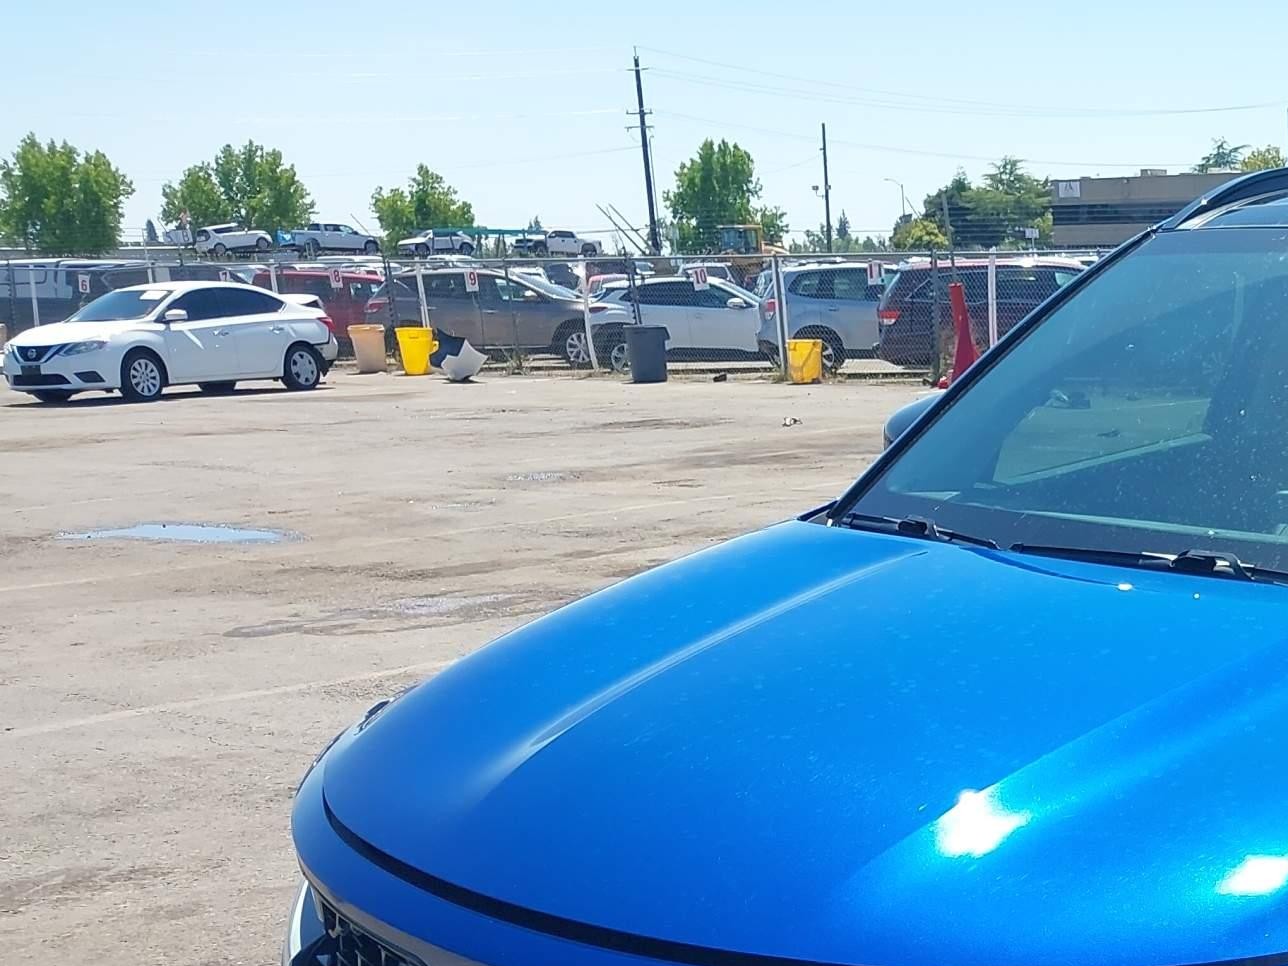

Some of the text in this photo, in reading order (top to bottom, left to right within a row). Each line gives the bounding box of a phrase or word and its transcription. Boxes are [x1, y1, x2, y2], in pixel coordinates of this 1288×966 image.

[333, 269, 341, 282] 8
[469, 271, 477, 286] 9
[694, 268, 707, 284] 10
[81, 279, 88, 291] 6
